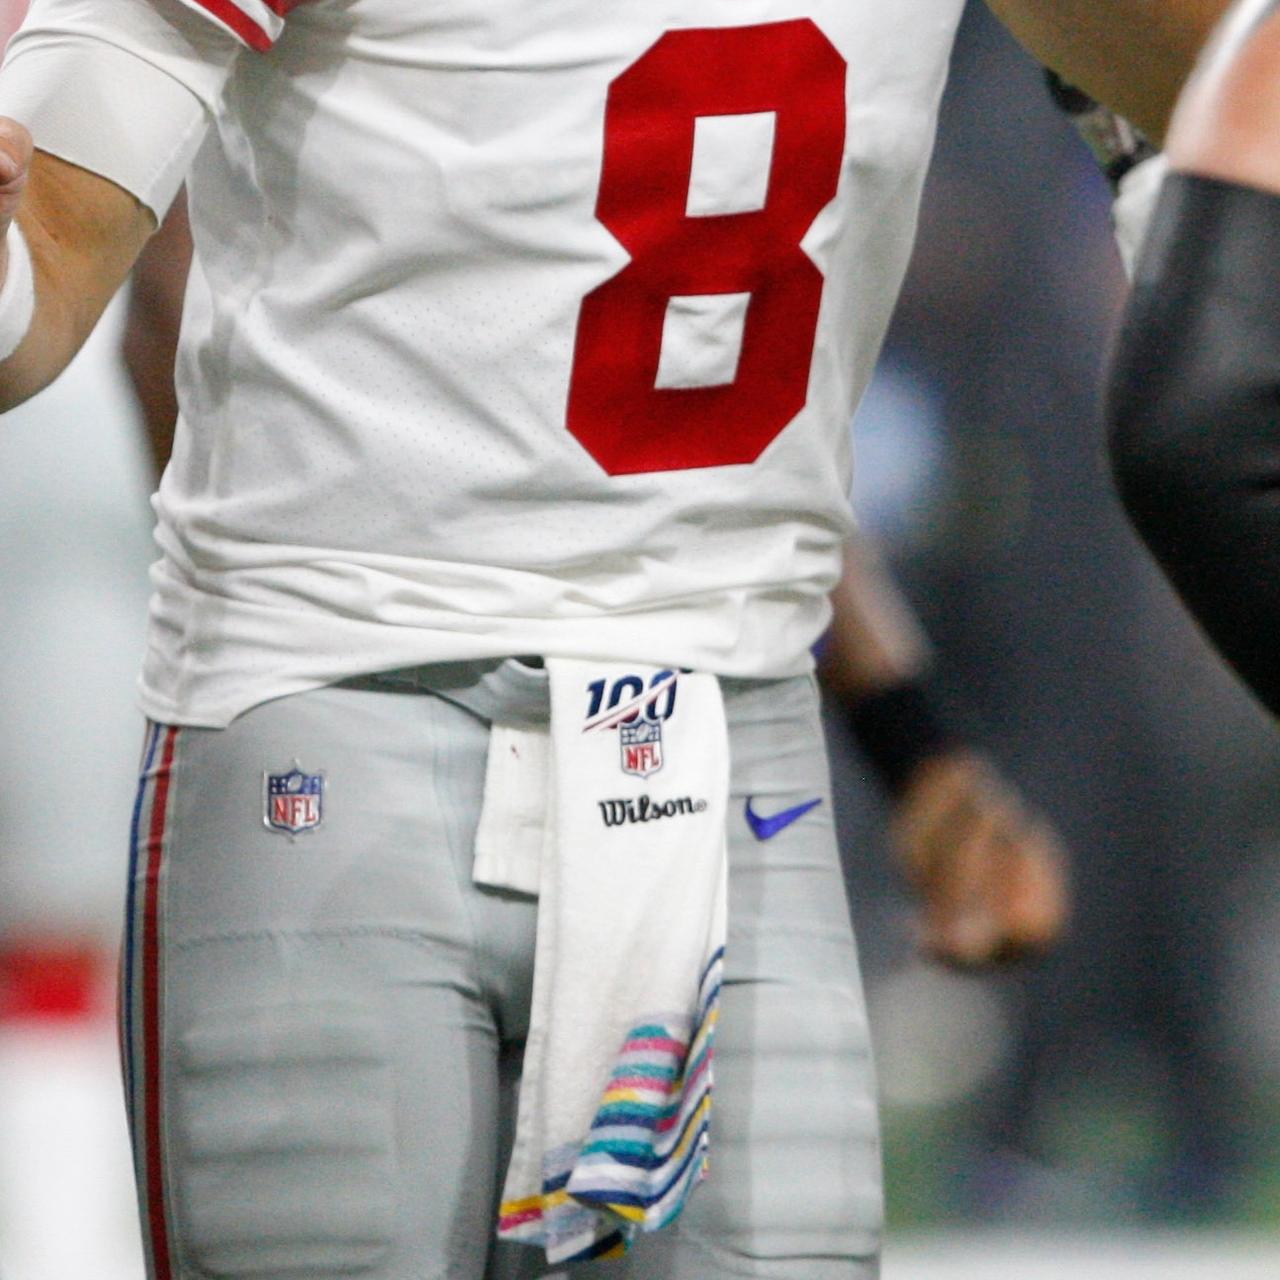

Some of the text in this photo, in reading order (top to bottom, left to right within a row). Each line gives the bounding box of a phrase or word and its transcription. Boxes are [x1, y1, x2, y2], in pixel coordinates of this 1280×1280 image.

[564, 17, 848, 478] 8
[624, 744, 660, 771] NFL
[273, 794, 317, 827] NFL
[597, 793, 696, 828] Wilson
